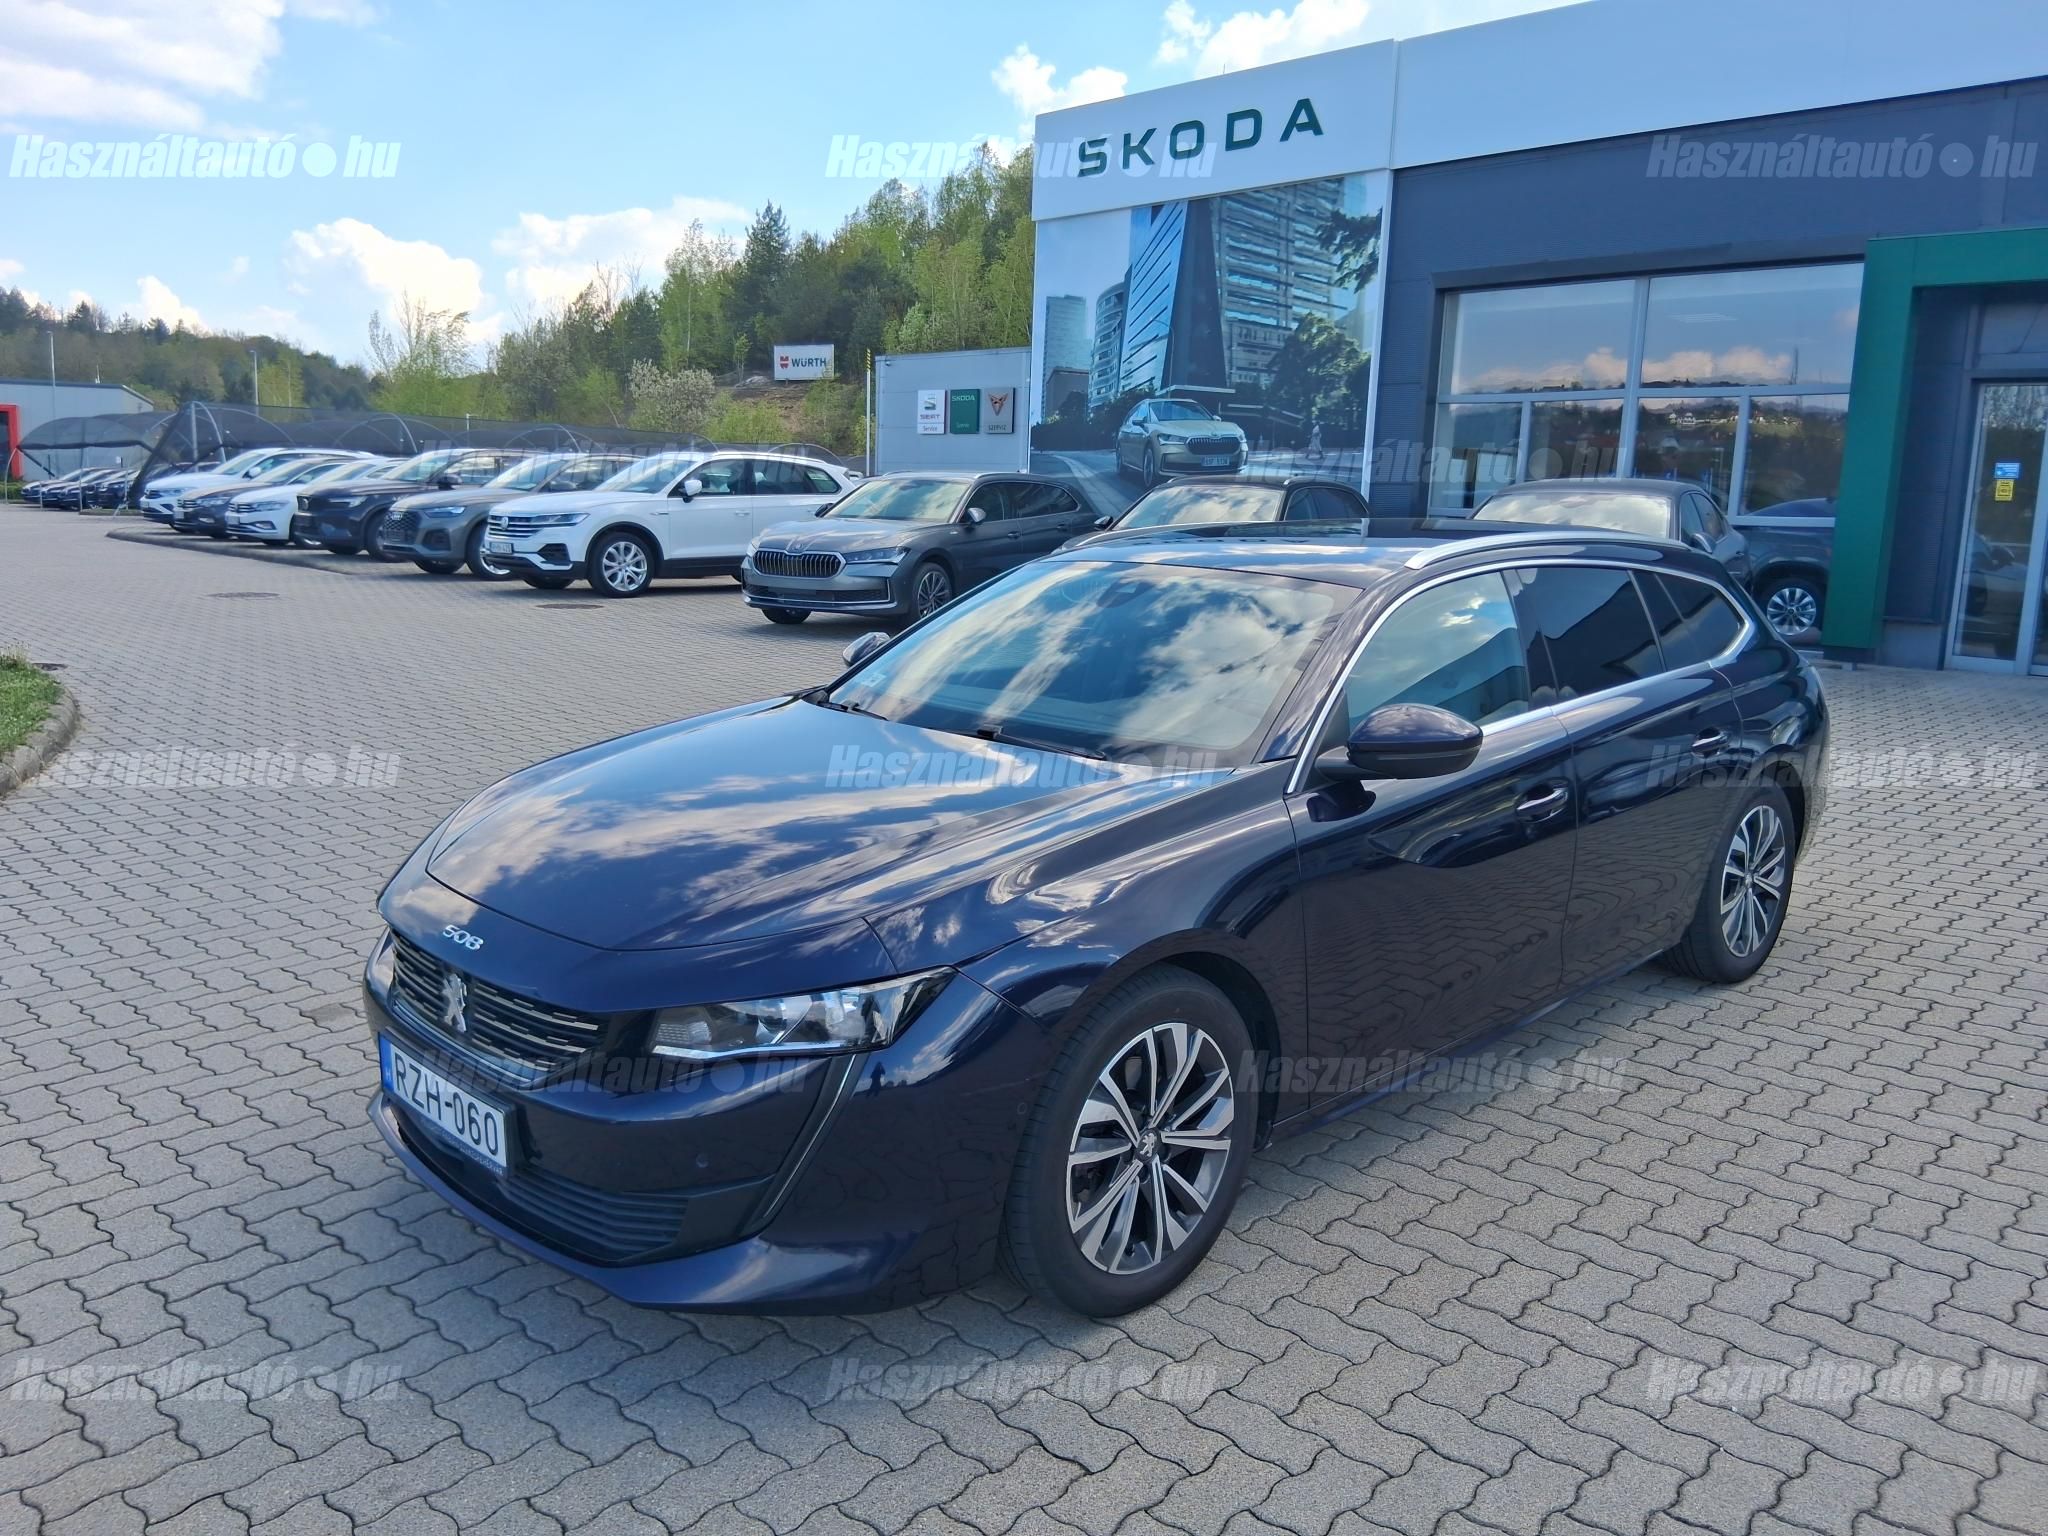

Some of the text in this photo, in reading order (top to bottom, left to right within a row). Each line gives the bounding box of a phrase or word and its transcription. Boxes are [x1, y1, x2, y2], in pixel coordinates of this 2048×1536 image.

[791, 357, 827, 368] WÜRTH
[443, 925, 483, 950] 508
[394, 1052, 499, 1156] RZH-060
